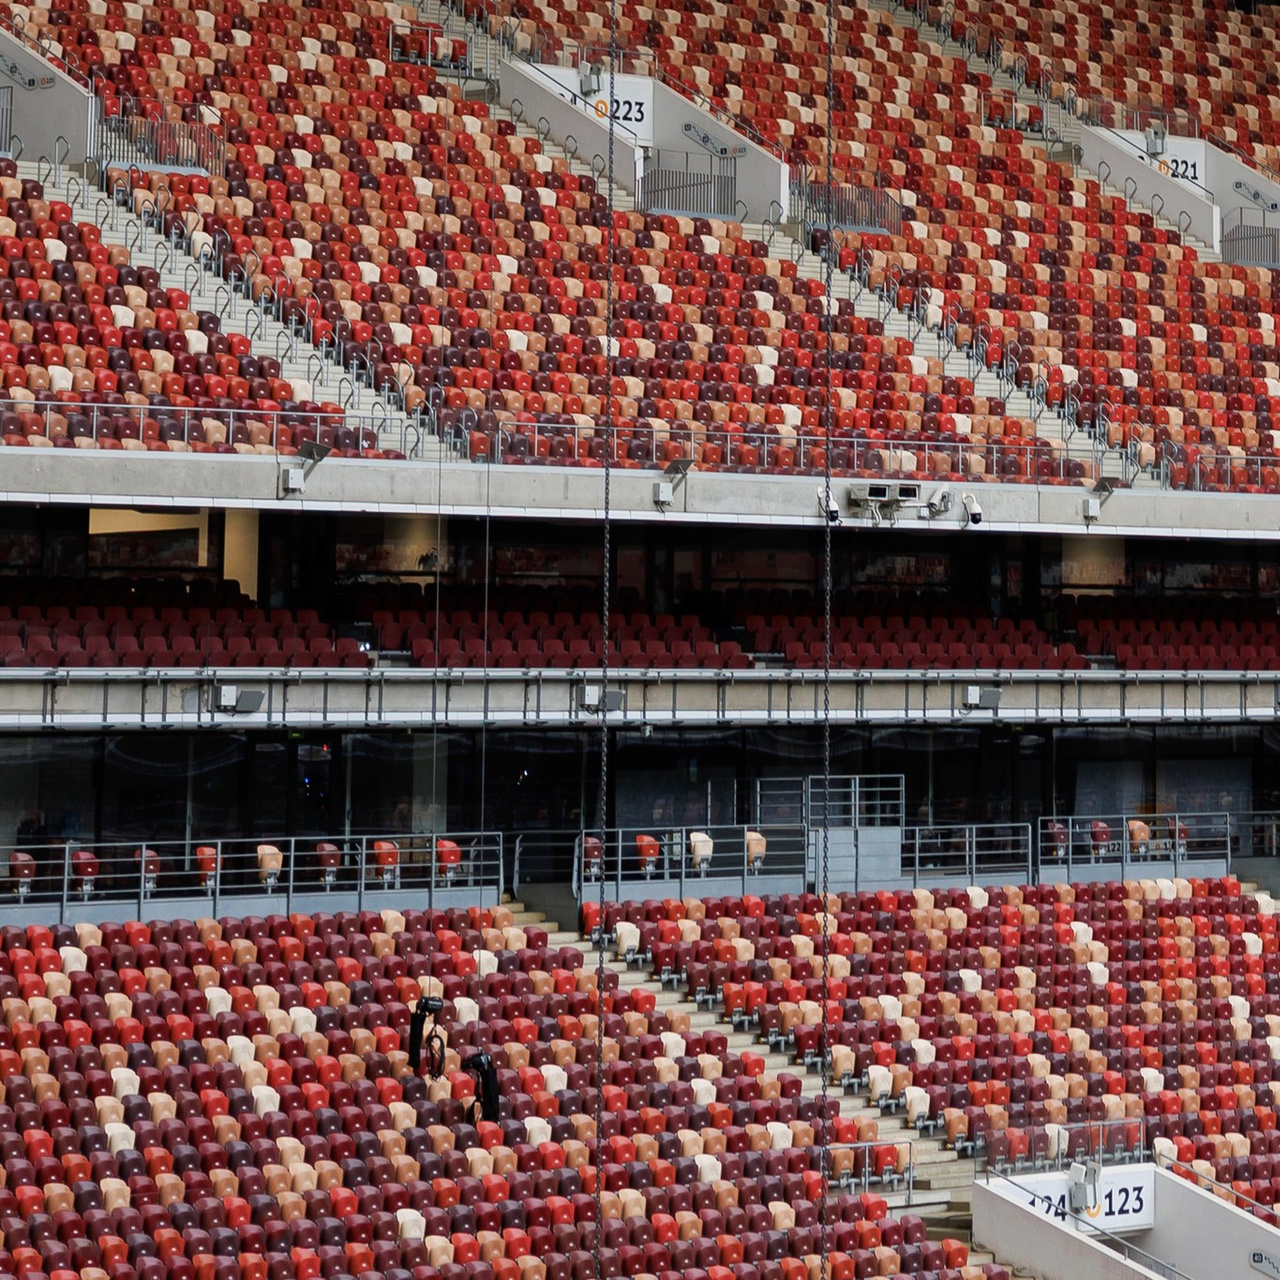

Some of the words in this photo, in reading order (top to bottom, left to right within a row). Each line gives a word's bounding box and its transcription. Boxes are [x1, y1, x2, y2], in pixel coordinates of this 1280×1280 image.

[610, 99, 644, 122] 223
[1171, 159, 1198, 180] 221
[1104, 1186, 1143, 1216] 123
